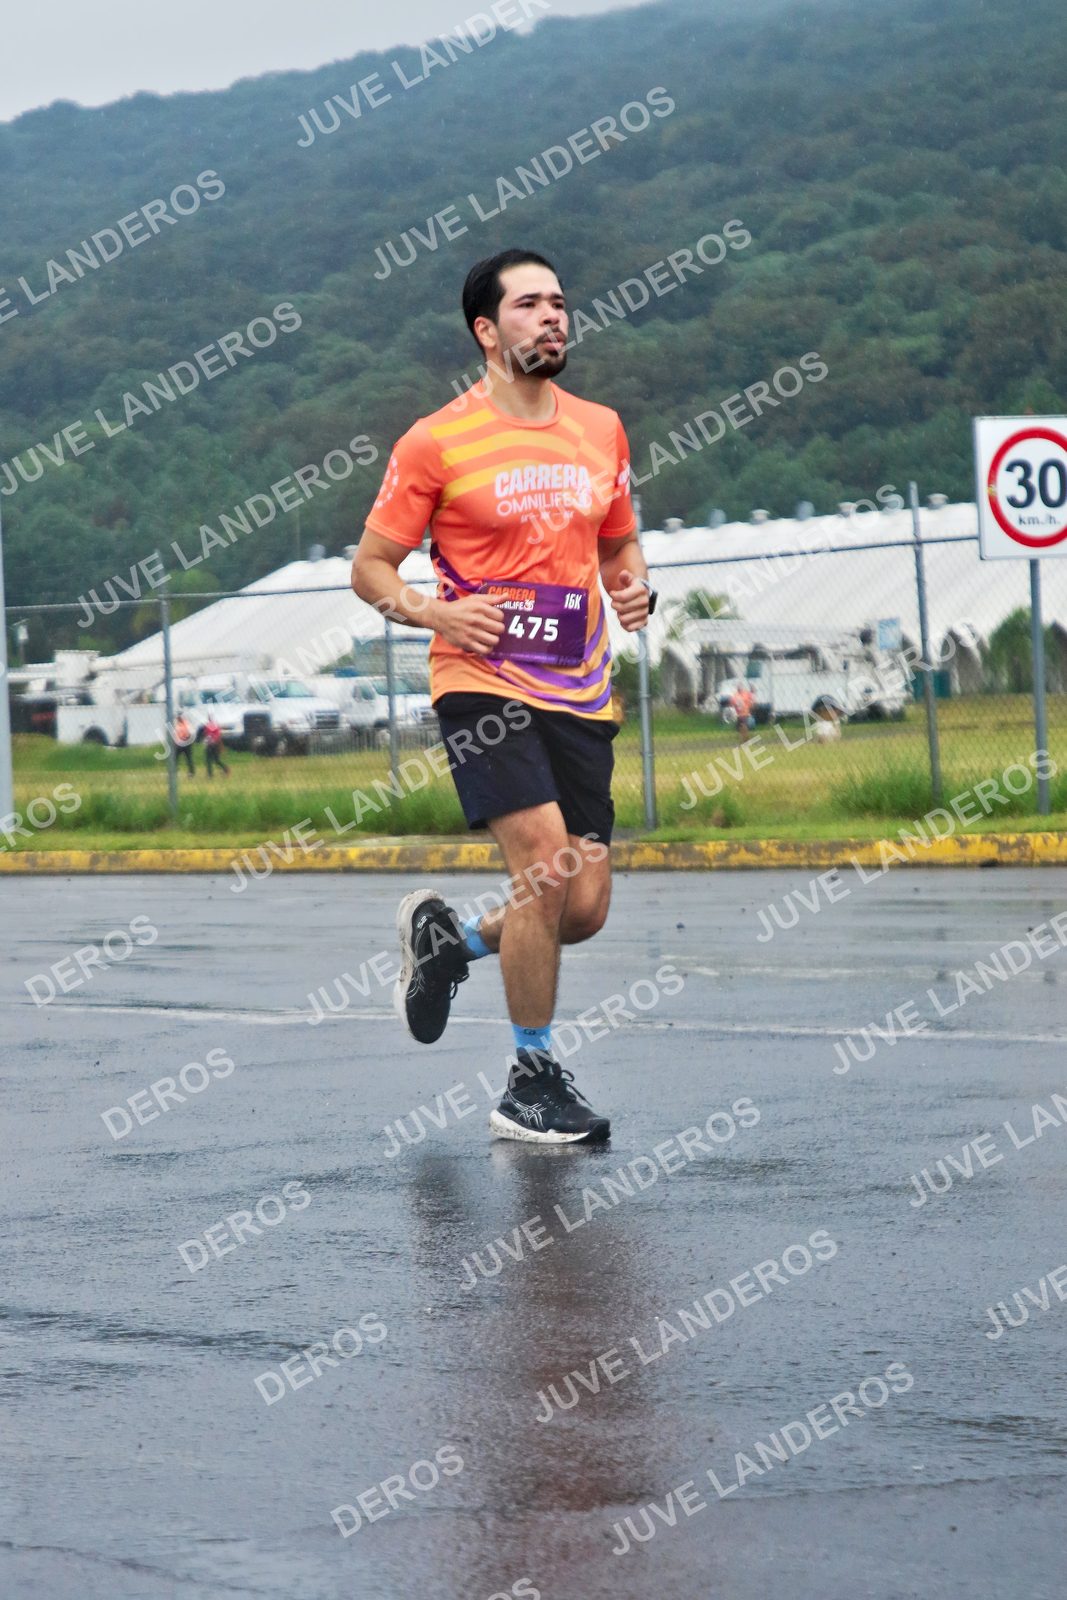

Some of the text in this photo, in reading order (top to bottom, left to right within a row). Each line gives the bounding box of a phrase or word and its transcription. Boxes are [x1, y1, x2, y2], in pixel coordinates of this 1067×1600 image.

[495, 463, 592, 498] CARRERA
[1005, 458, 1067, 508] 30
[496, 491, 573, 516] OMNILIFE
[564, 592, 583, 610] 16K
[508, 615, 559, 642] 475
